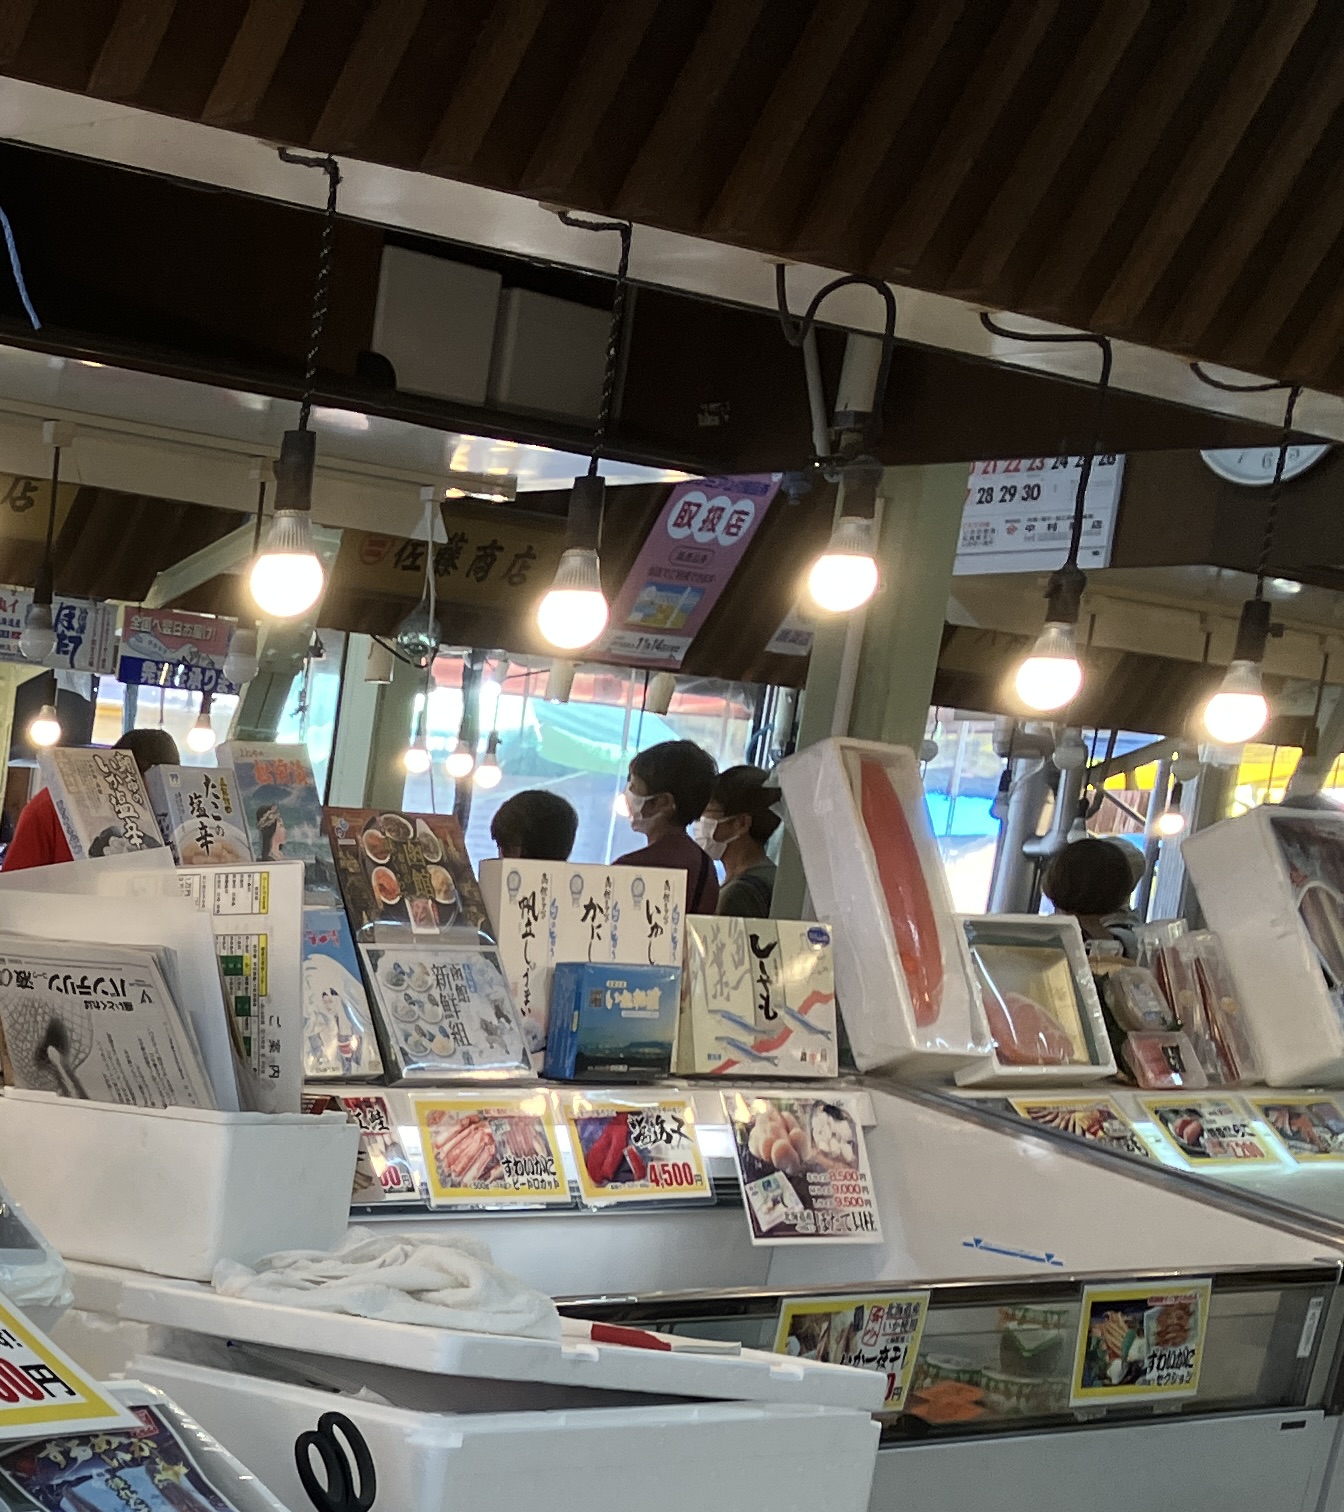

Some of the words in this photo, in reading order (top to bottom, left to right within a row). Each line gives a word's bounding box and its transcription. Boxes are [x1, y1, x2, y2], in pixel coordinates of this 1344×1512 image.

[977, 487, 994, 504] 28
[1000, 485, 1017, 503] 29
[1022, 484, 1041, 501] 30
[672, 501, 750, 537] 取扱店
[189, 792, 215, 857] 塩辛
[48, 974, 126, 997] バンテリン
[649, 1162, 703, 1188] 4,500円
